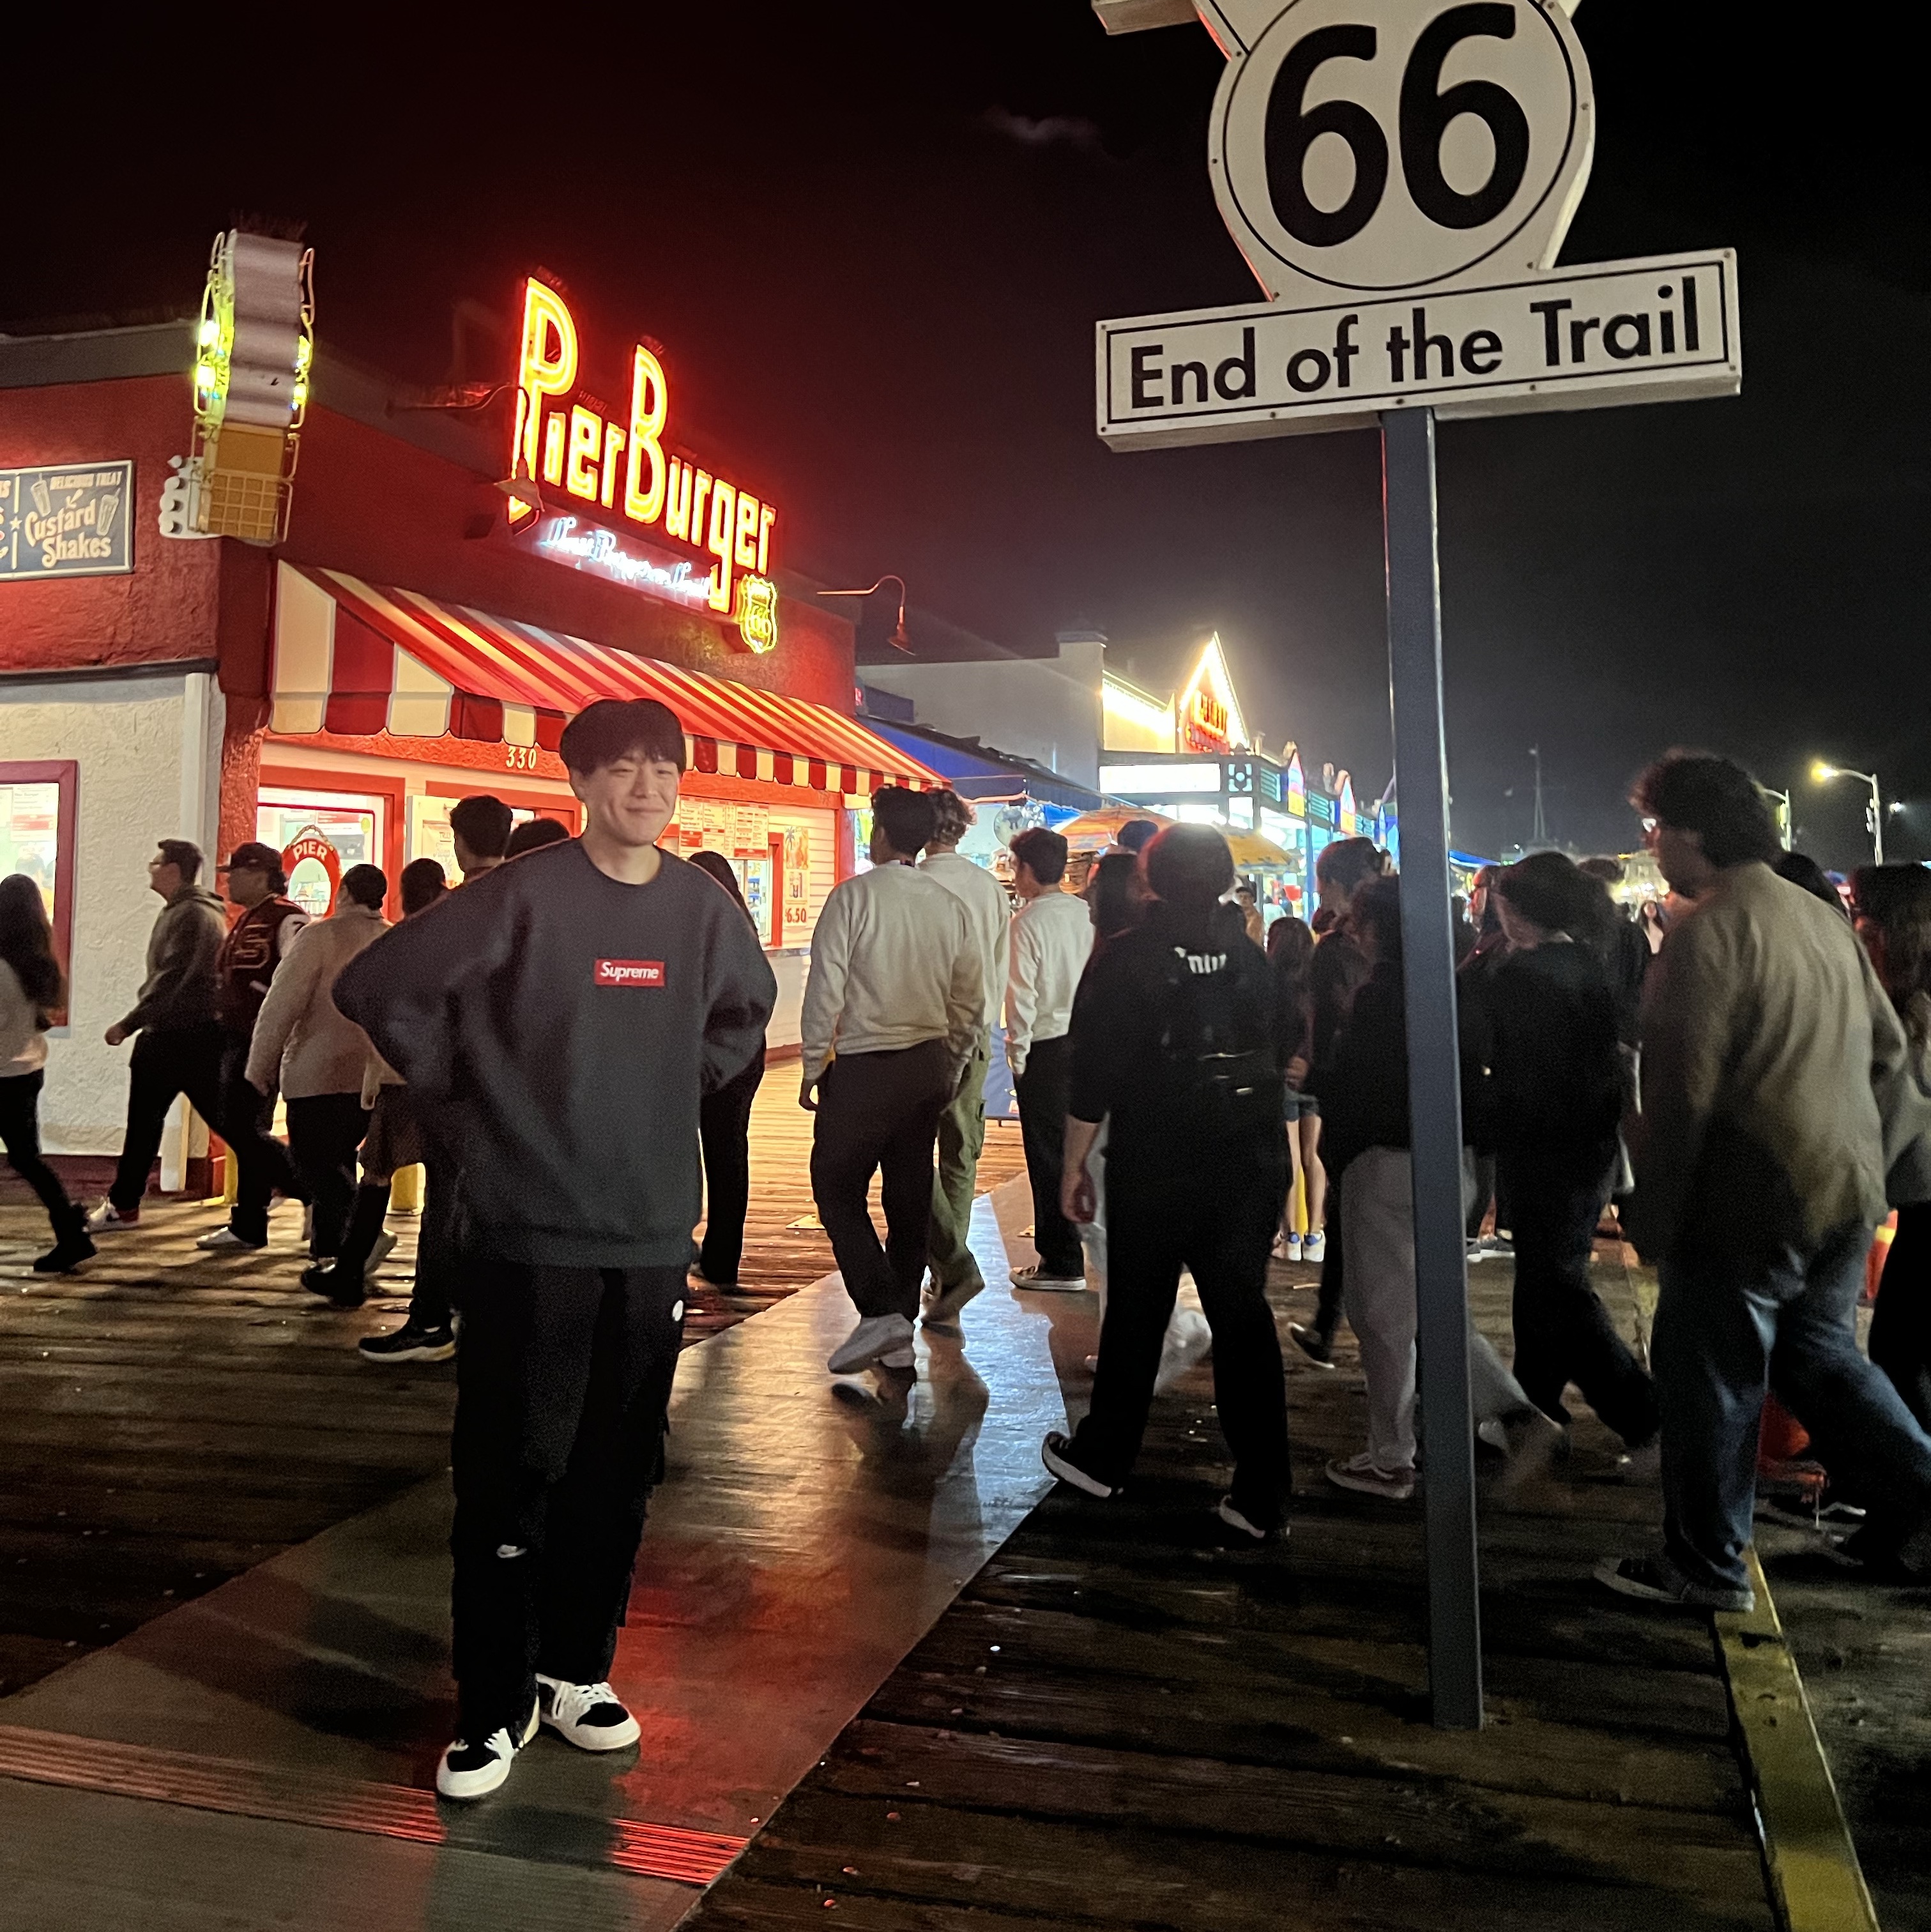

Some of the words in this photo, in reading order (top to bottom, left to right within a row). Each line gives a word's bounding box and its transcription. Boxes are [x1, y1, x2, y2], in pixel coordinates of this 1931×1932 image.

[1264, 2, 1530, 248] 66
[1131, 326, 1256, 409] End
[1286, 314, 1359, 393] of
[1385, 307, 1502, 383] the
[1530, 276, 1700, 367] Trail
[24, 498, 96, 547] Custard
[42, 531, 112, 568] Shakes
[505, 745, 537, 769] 330
[293, 840, 328, 862] PIER
[600, 961, 659, 981] Supreme
